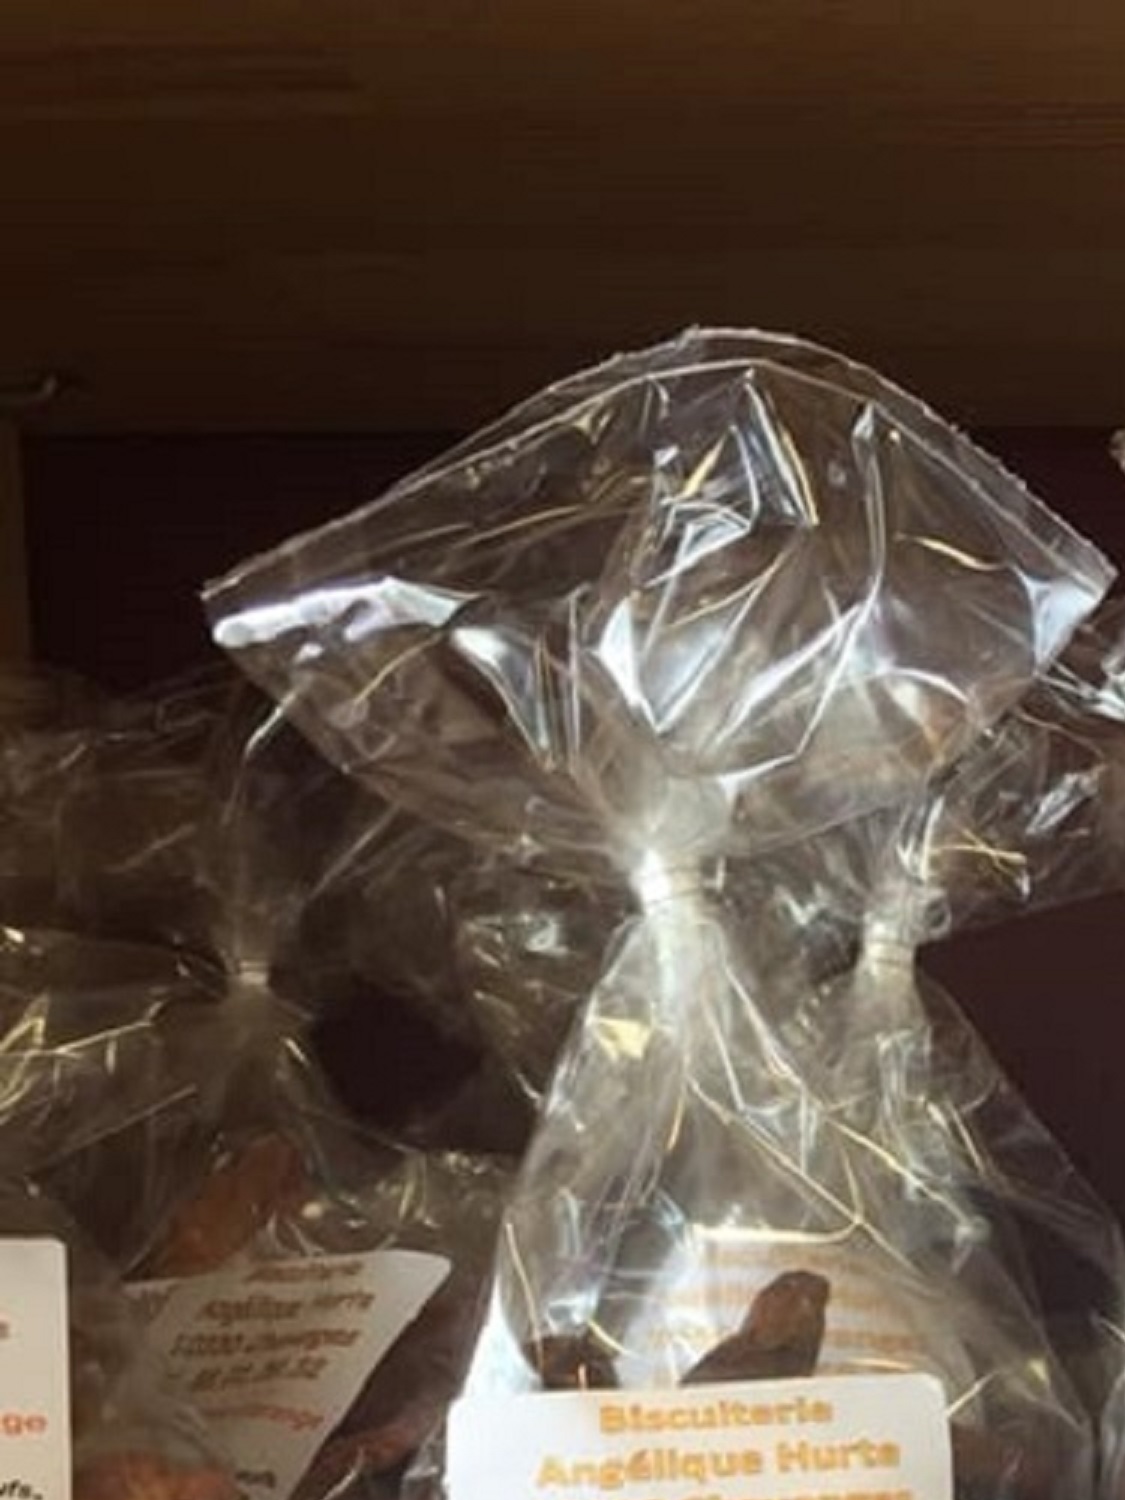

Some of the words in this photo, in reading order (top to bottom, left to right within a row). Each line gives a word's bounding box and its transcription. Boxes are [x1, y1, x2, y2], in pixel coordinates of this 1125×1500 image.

[599, 1397, 832, 1434] Biscuiterie
[536, 1446, 763, 1490] Angélique
[776, 1438, 901, 1473] Hurte
